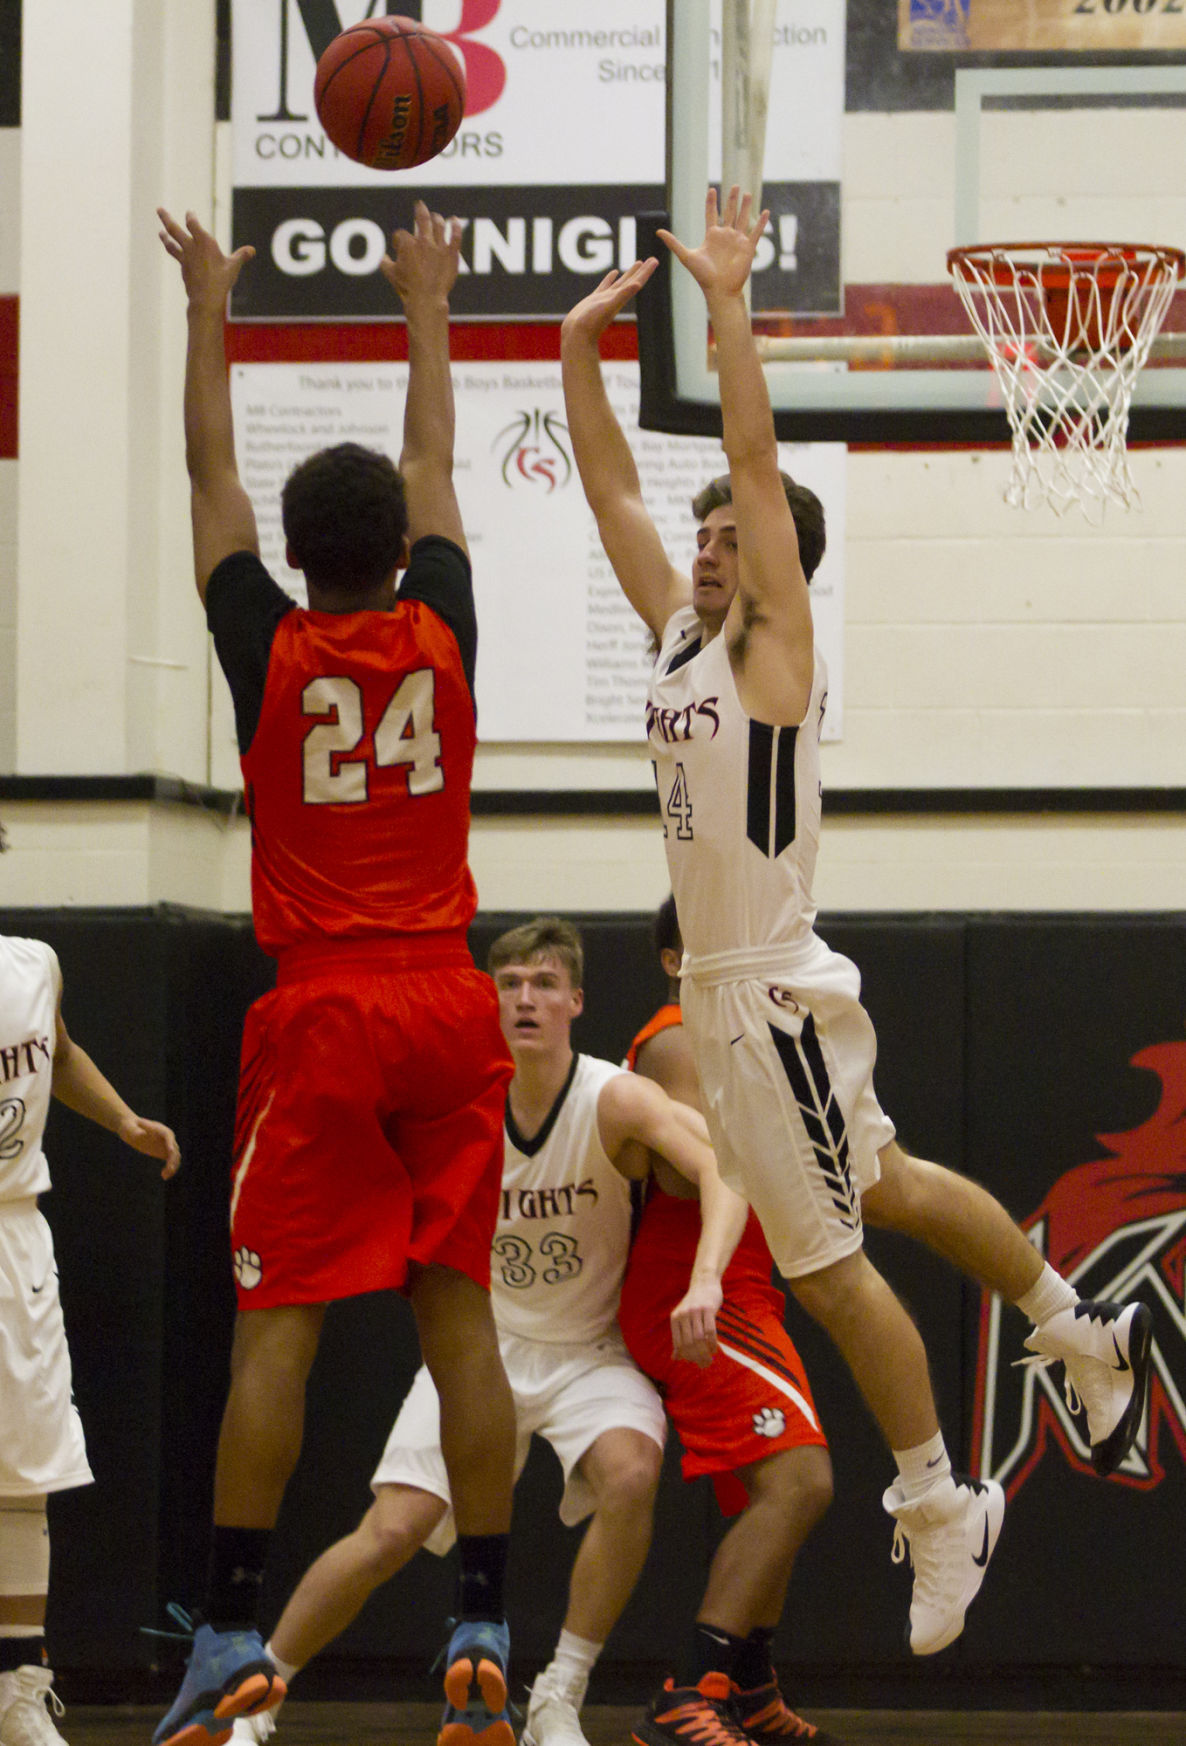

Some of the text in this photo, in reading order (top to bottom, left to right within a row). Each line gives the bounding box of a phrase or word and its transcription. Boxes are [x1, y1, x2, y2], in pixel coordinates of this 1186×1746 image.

[509, 26, 660, 49] Commercial
[598, 59, 666, 83] Since
[270, 217, 386, 275] GO
[302, 667, 444, 804] 24
[500, 1178, 599, 1220] IGHTS
[492, 1231, 584, 1289] 33
